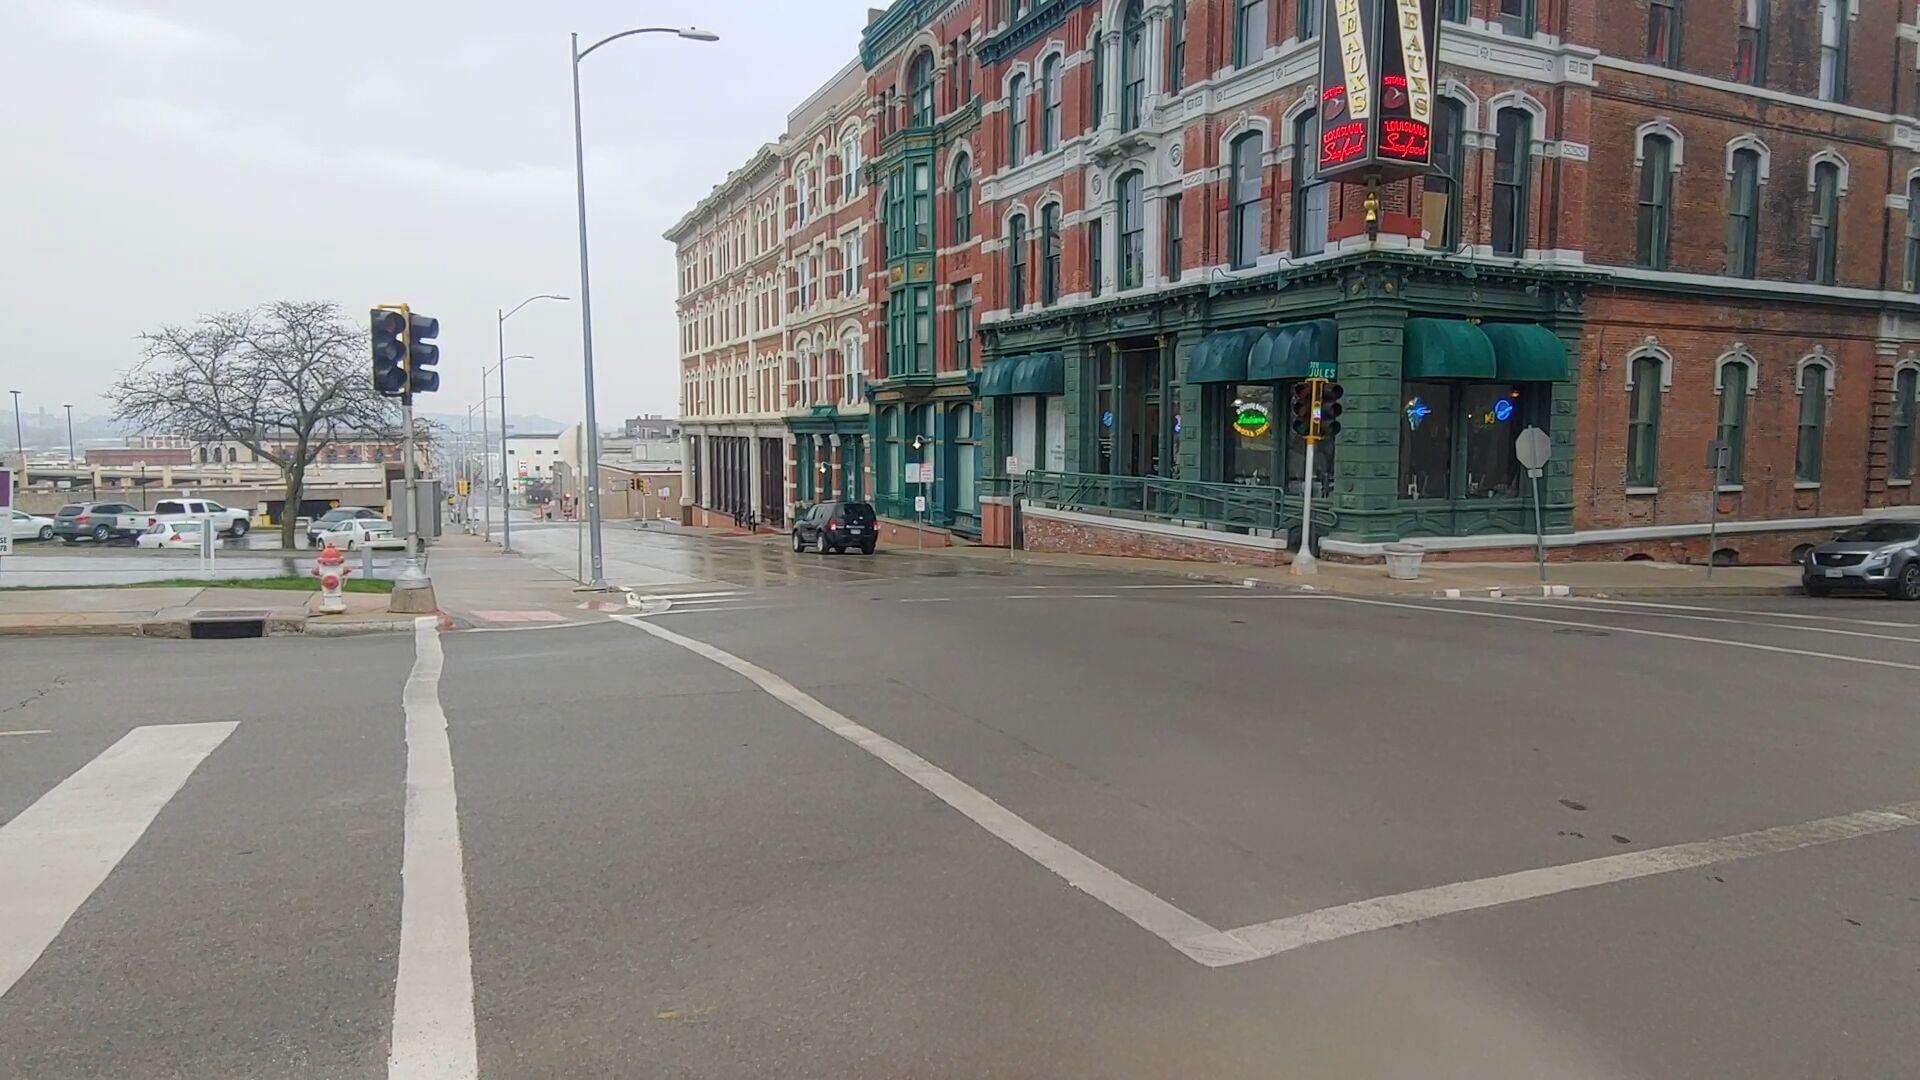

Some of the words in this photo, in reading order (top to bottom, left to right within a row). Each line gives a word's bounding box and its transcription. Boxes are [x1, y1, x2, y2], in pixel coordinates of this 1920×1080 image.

[1320, 134, 1367, 162] Seafood
[1379, 132, 1429, 158] Seafood
[1308, 368, 1336, 378] JULES
